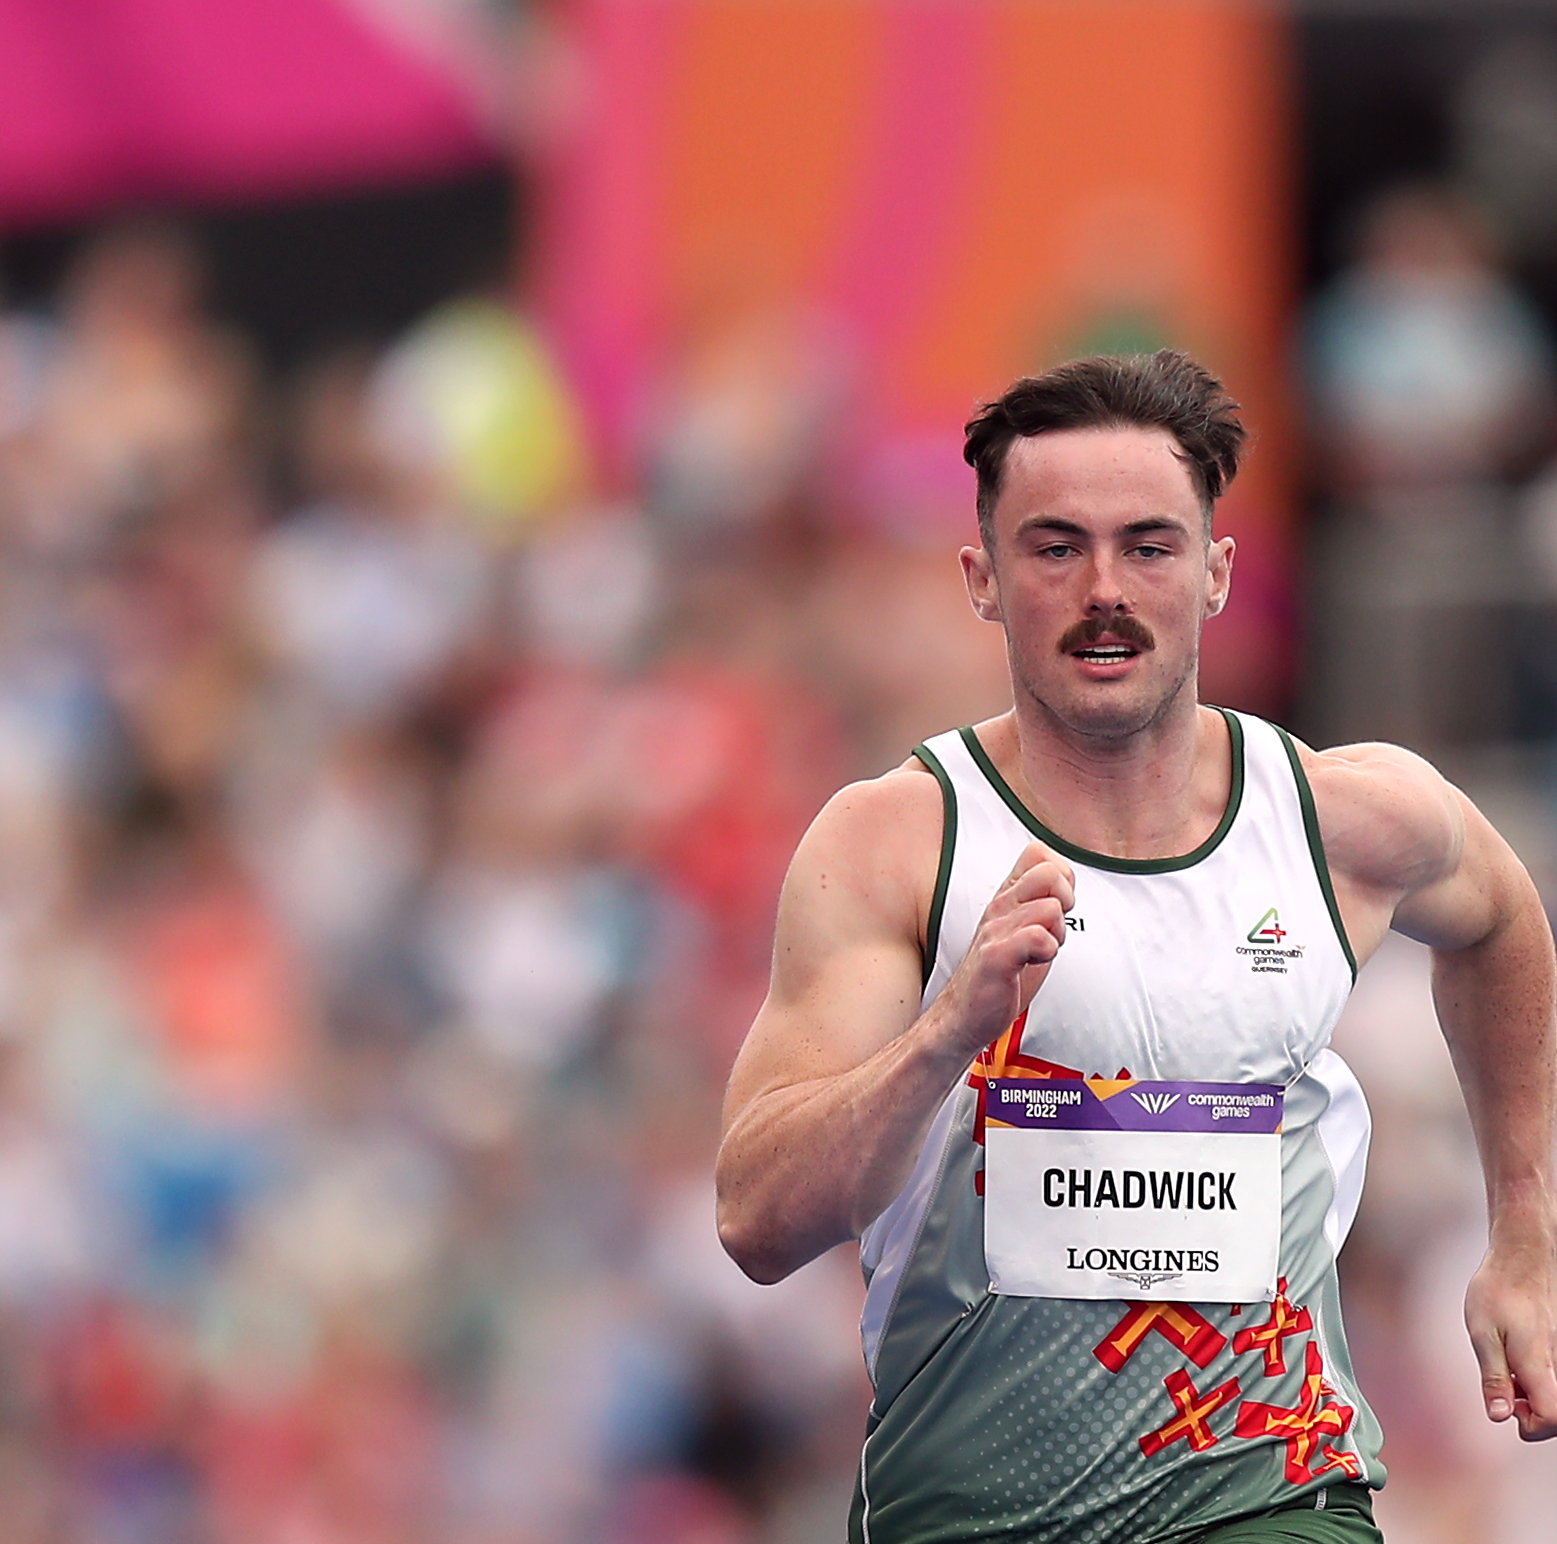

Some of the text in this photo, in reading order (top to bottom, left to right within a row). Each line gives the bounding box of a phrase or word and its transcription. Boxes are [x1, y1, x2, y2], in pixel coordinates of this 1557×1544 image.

[1000, 1089, 1082, 1105] BIRMINGHAM
[1187, 1093, 1274, 1107] commonwealth
[1025, 1103, 1057, 1118] 2022
[1212, 1105, 1250, 1120] games
[1043, 1168, 1238, 1211] CHADWICK
[1066, 1248, 1220, 1272] LONGINES
